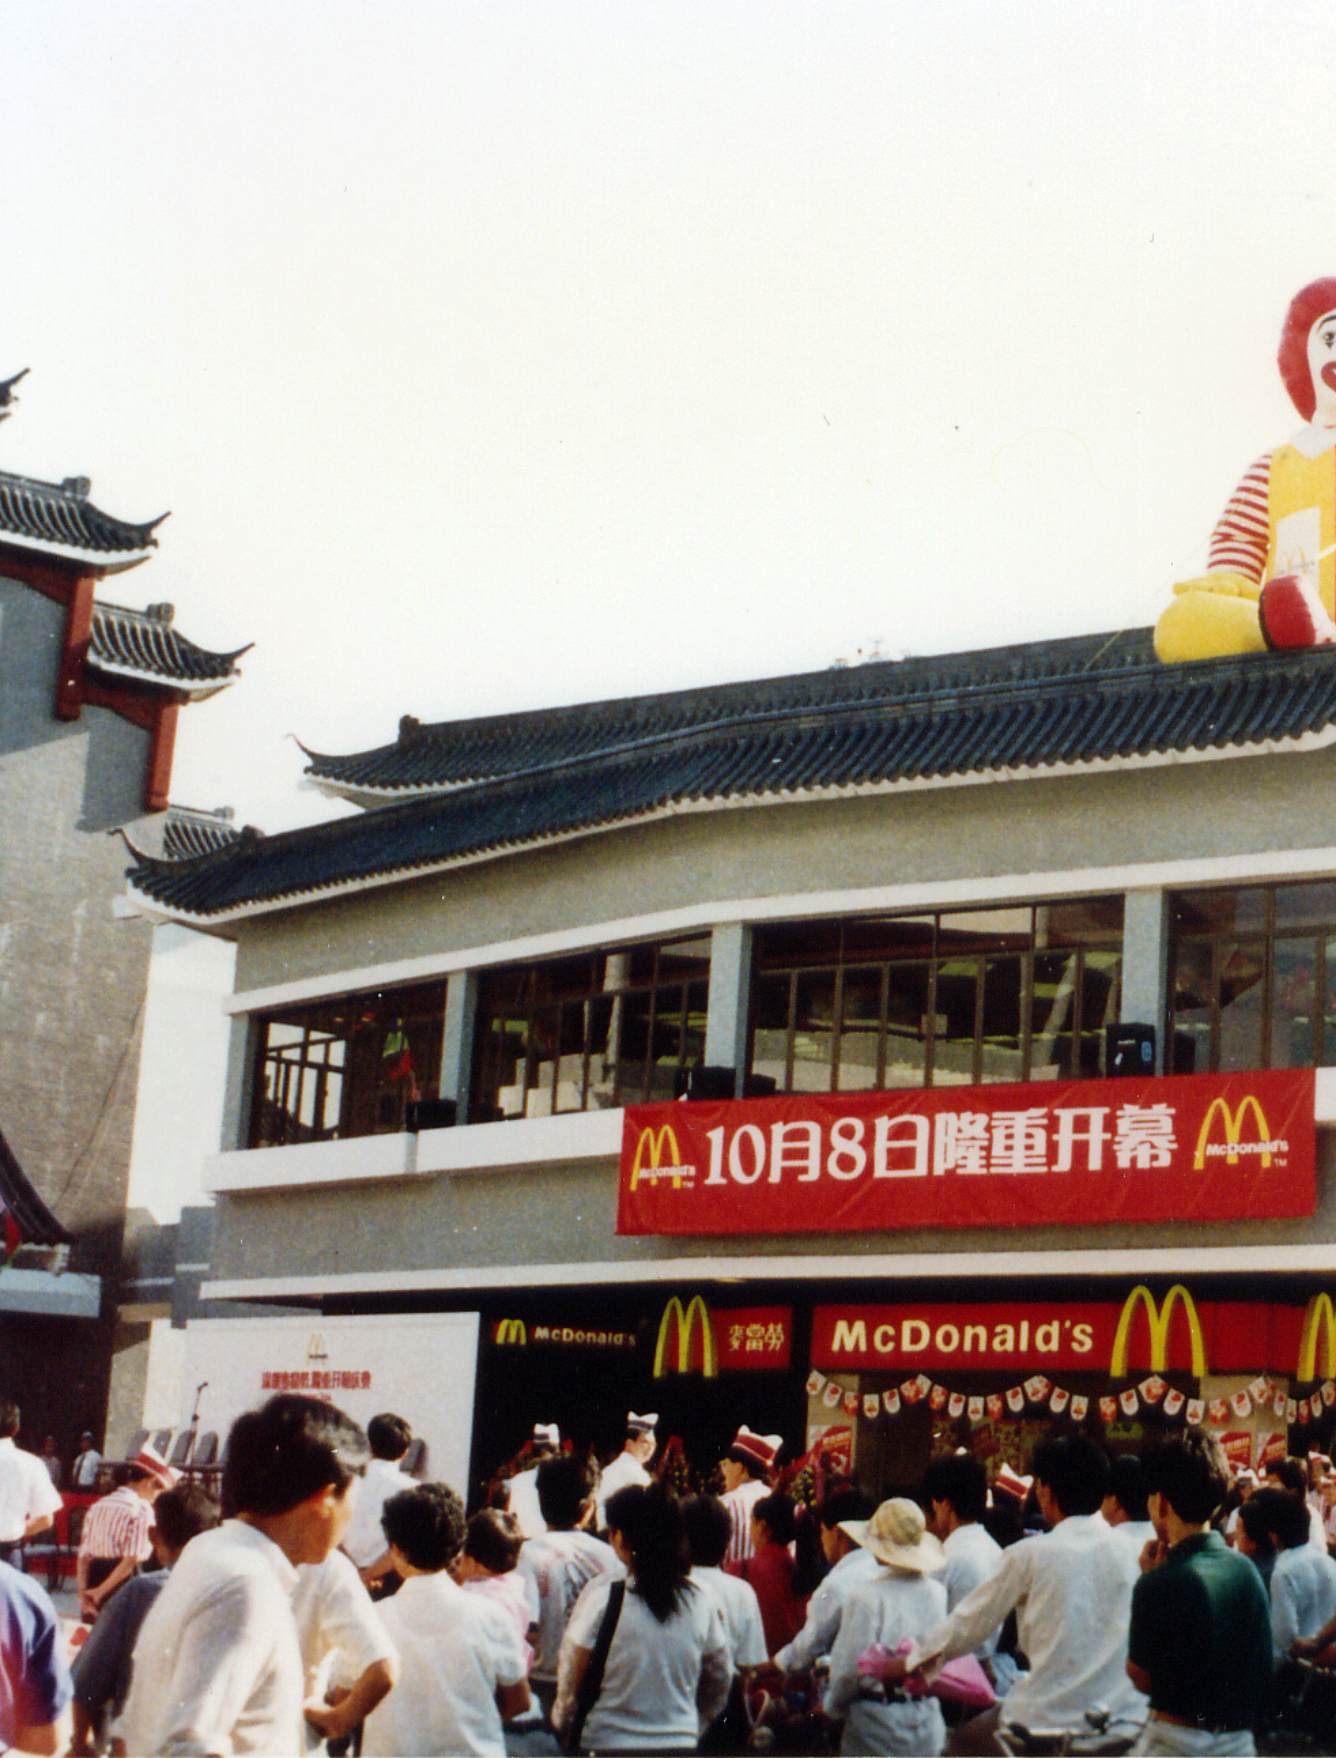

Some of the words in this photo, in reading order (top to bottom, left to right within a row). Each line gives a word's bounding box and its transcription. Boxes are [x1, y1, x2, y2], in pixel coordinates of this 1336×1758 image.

[705, 1104, 1178, 1185] 10月8日隆重开幕
[1207, 1140, 1288, 1156] McDonald's
[729, 1322, 786, 1352] 麥當勞
[831, 1317, 1094, 1353] McDonald's
